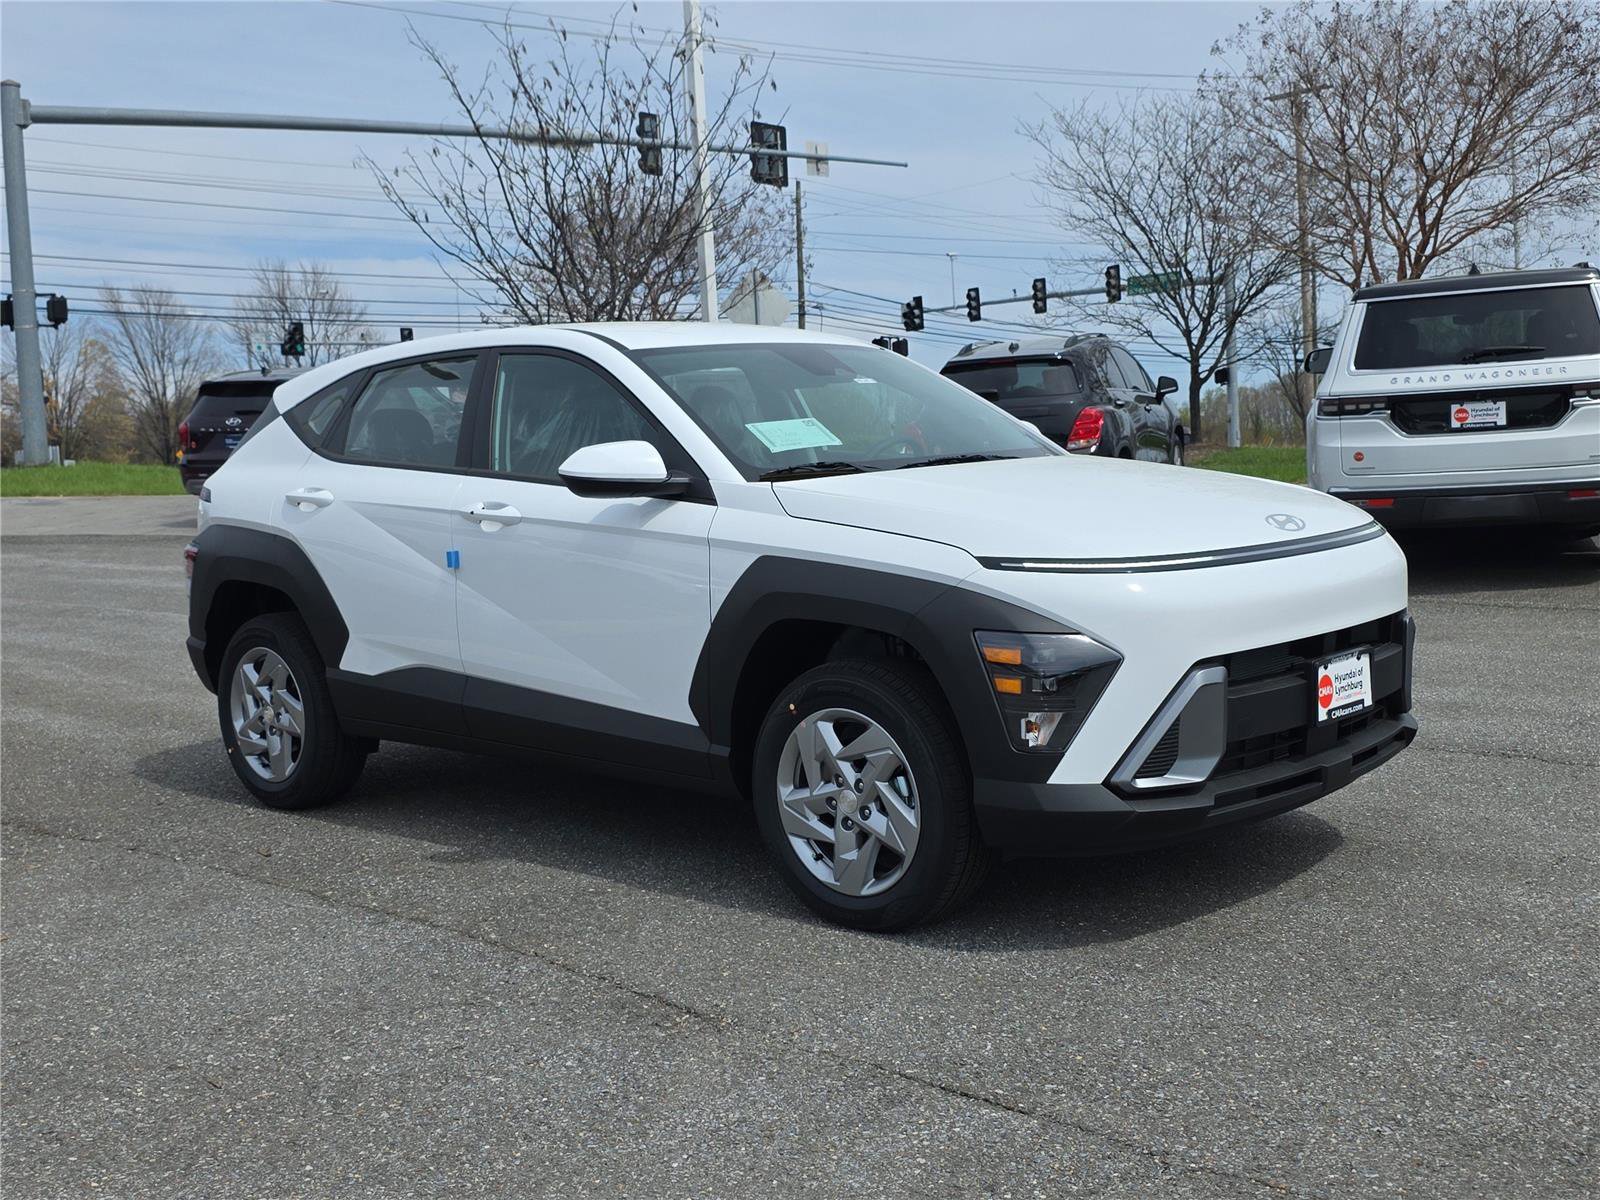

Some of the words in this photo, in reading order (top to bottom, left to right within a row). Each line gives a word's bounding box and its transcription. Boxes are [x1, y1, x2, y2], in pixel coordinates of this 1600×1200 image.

[1390, 374, 1451, 385] GRAND
[1464, 366, 1568, 381] WAGONEER
[1334, 668, 1357, 684] Hyundai
[1357, 666, 1363, 677] of
[1335, 680, 1363, 696] Lynchburg
